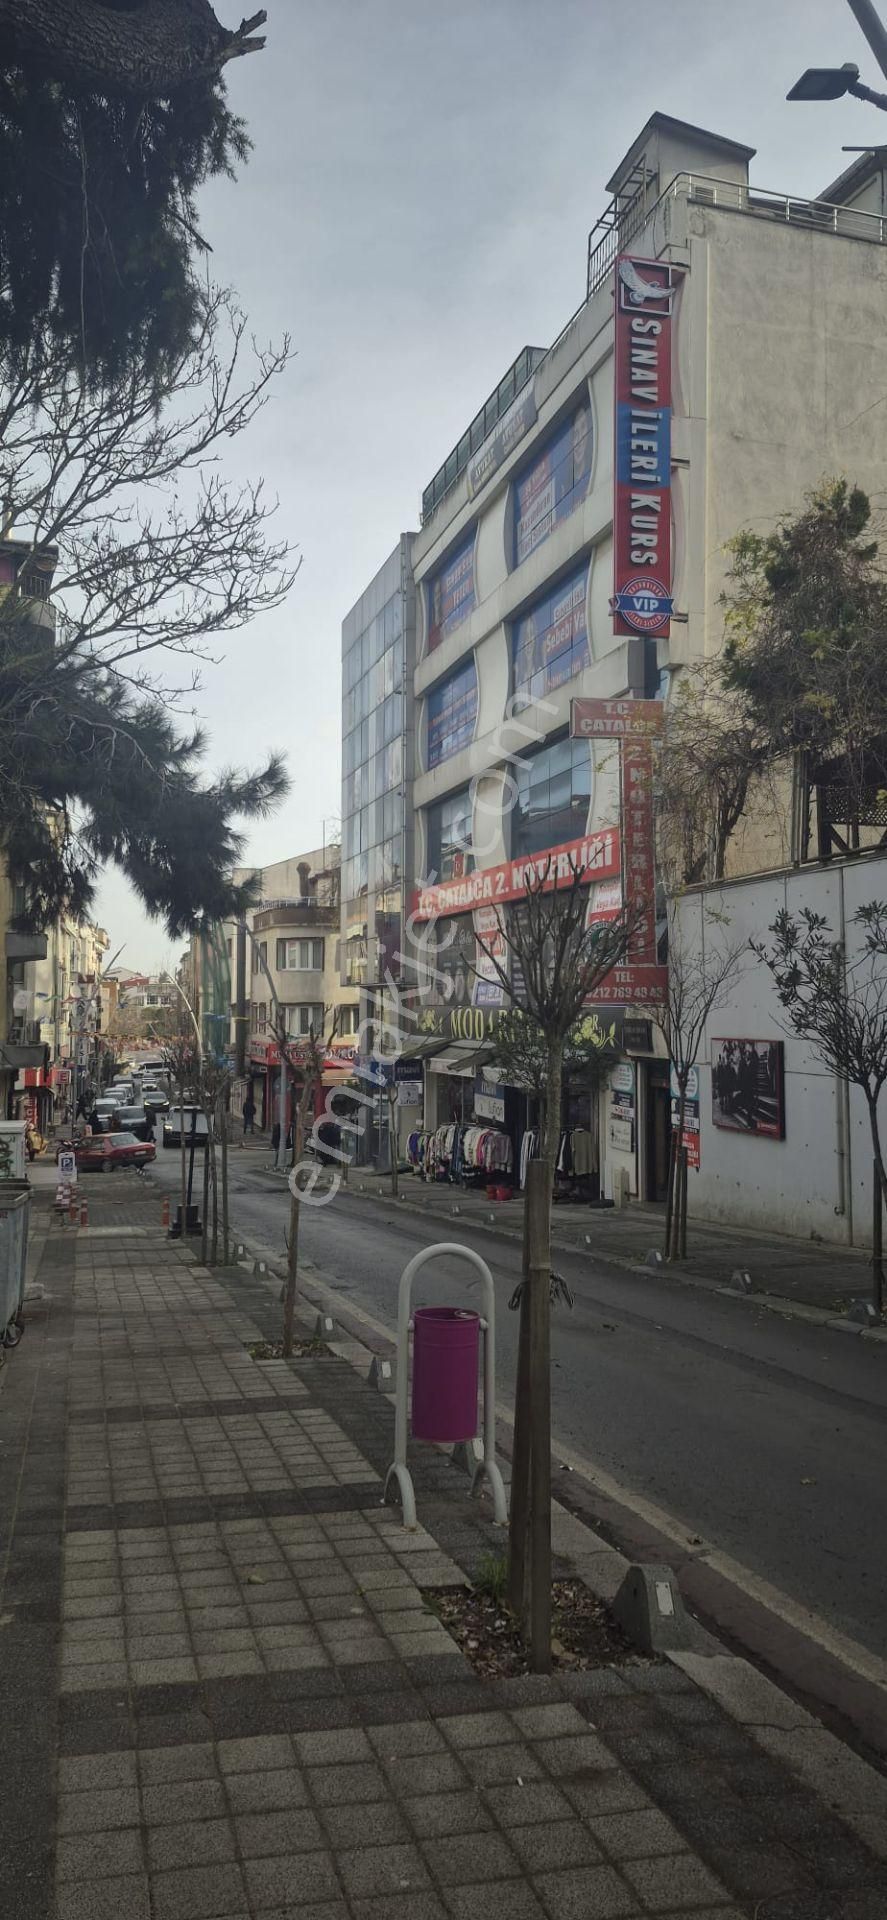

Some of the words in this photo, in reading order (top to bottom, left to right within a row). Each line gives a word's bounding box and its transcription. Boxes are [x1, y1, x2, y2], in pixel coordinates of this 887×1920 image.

[630, 317, 662, 403] SINAV
[630, 409, 663, 485] İLERİ
[630, 493, 662, 566] KURS
[633, 597, 659, 612] VIP
[581, 718, 657, 734] ÇATAL
[496, 871, 510, 896] 2.
[512, 833, 613, 890] NOTERLİĞİ
[612, 986, 633, 998] 769
[614, 971, 635, 983] TEL:
